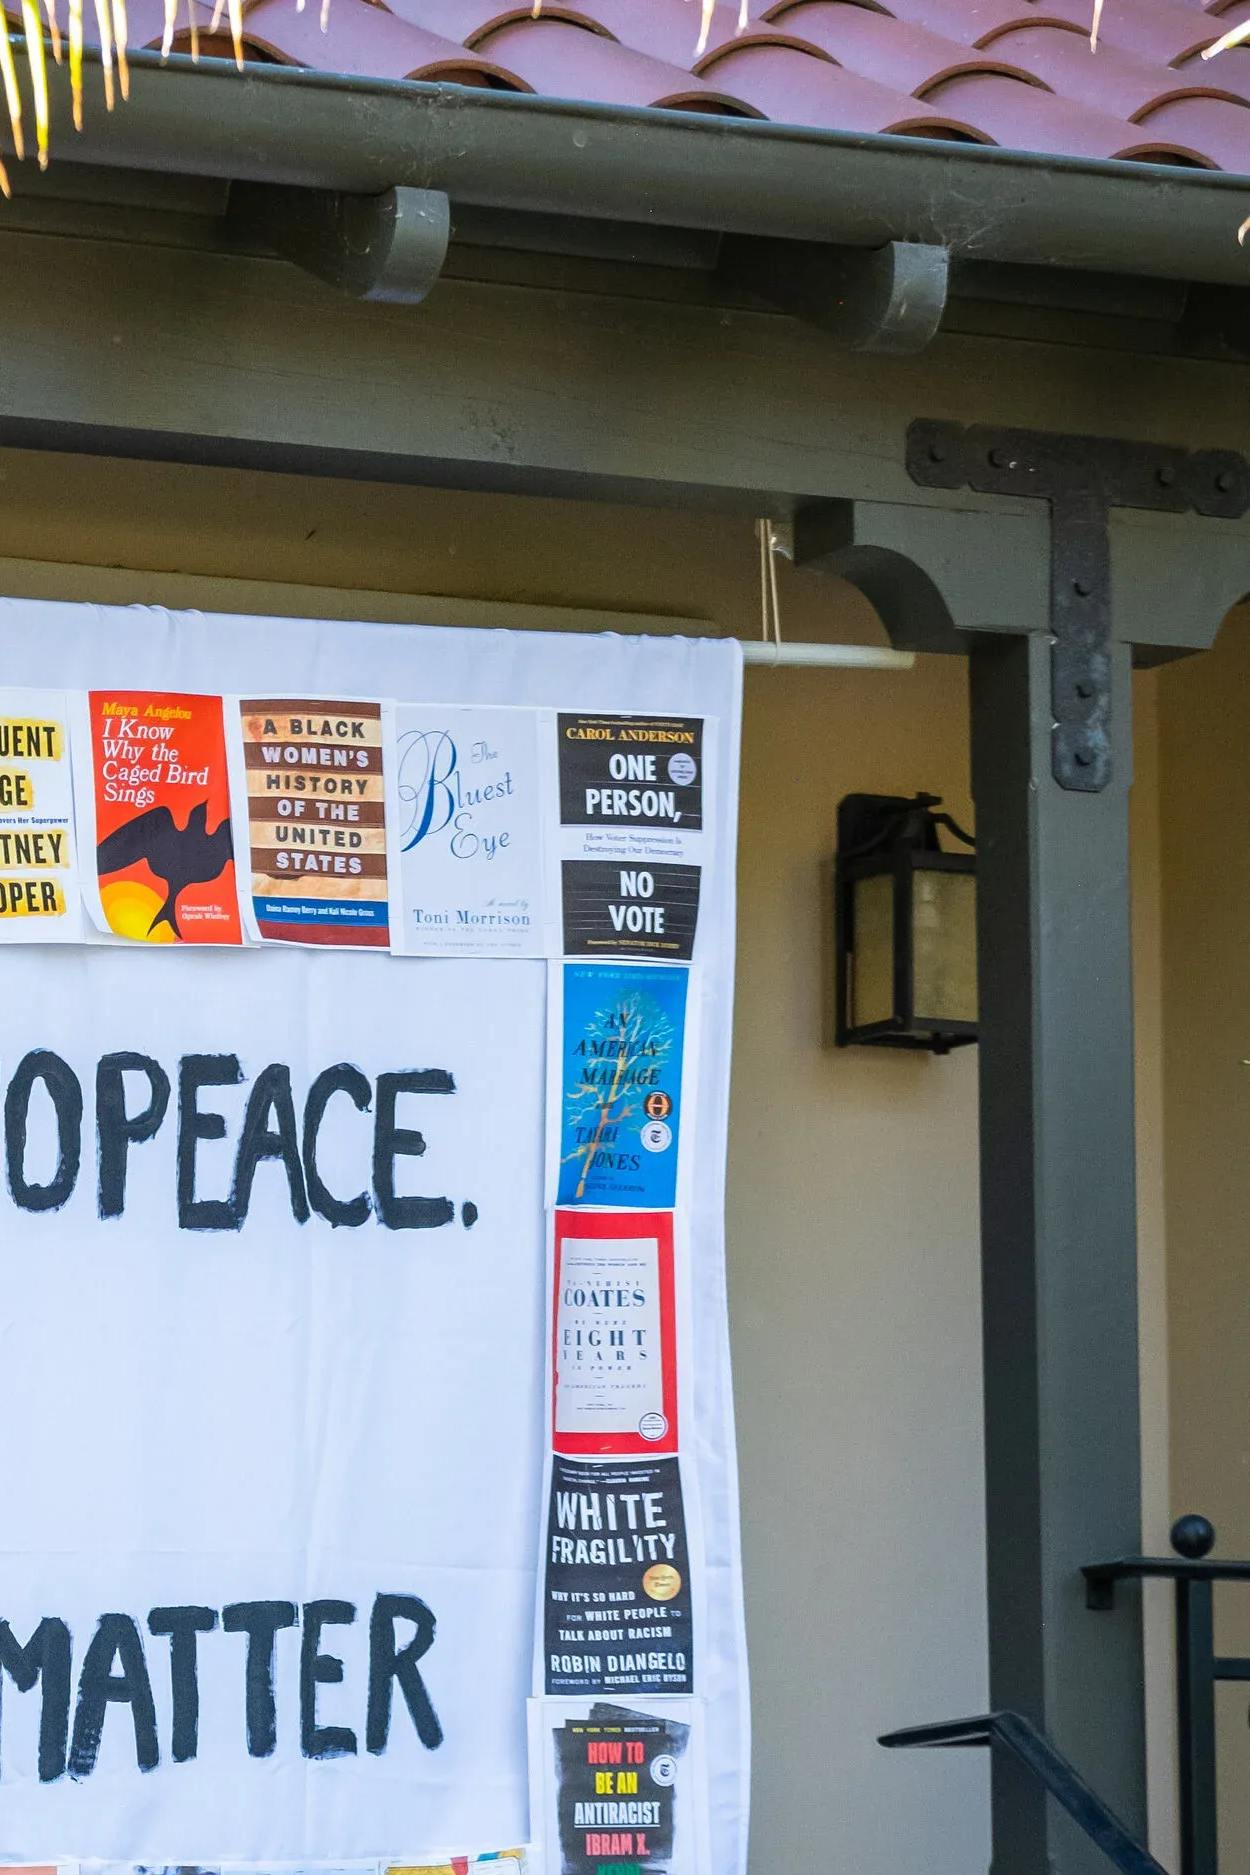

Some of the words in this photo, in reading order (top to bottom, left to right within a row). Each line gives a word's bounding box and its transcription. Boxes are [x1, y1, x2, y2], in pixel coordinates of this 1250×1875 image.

[102, 718, 113, 739] I
[118, 718, 174, 741] Know
[263, 719, 277, 735] A
[290, 719, 365, 738] BLACK
[566, 728, 615, 740] CAROL
[619, 729, 694, 744] ANDERSON
[103, 740, 145, 764] Why
[151, 743, 178, 762] the
[261, 746, 369, 768] WOMEN'S
[470, 741, 498, 764] The
[103, 761, 162, 785] Caged
[166, 764, 209, 785] Bird
[609, 754, 657, 781] ONE
[104, 783, 155, 808] Sings
[266, 774, 368, 795] HISTORY
[277, 799, 306, 817] OF
[316, 802, 360, 821] THE
[585, 788, 682, 823] PERSON,
[275, 825, 362, 848] UNITED
[451, 812, 510, 860] Eye
[276, 851, 362, 874] STATES
[619, 870, 654, 898] NO
[413, 909, 449, 924] Toni
[456, 910, 530, 925] Morrison
[608, 905, 665, 934] VOTE
[572, 1038, 658, 1057] AMERICAN
[580, 1068, 662, 1086] MARRIAGE
[96, 1051, 478, 1232] PEACE.
[564, 1289, 646, 1307] COATES
[564, 1329, 646, 1346] EIGHT
[563, 1350, 647, 1361] YEARS
[556, 1491, 667, 1531] WHITE
[552, 1533, 676, 1566] FRAGILITY
[551, 1591, 568, 1601] WHY
[571, 1591, 589, 1602] IT'S
[593, 1591, 606, 1602] SO
[609, 1591, 636, 1601] HARD
[558, 1630, 585, 1641] TALK
[588, 1629, 624, 1641] ABOUT
[628, 1626, 672, 1640] RACISM
[587, 1742, 622, 1764] HOW
[626, 1741, 644, 1764] TO
[595, 1771, 614, 1794] BE
[616, 1771, 638, 1794] AN
[574, 1801, 661, 1826] ANTIRACIST
[585, 1833, 633, 1856] IBRAM
[636, 1833, 651, 1855] X.
